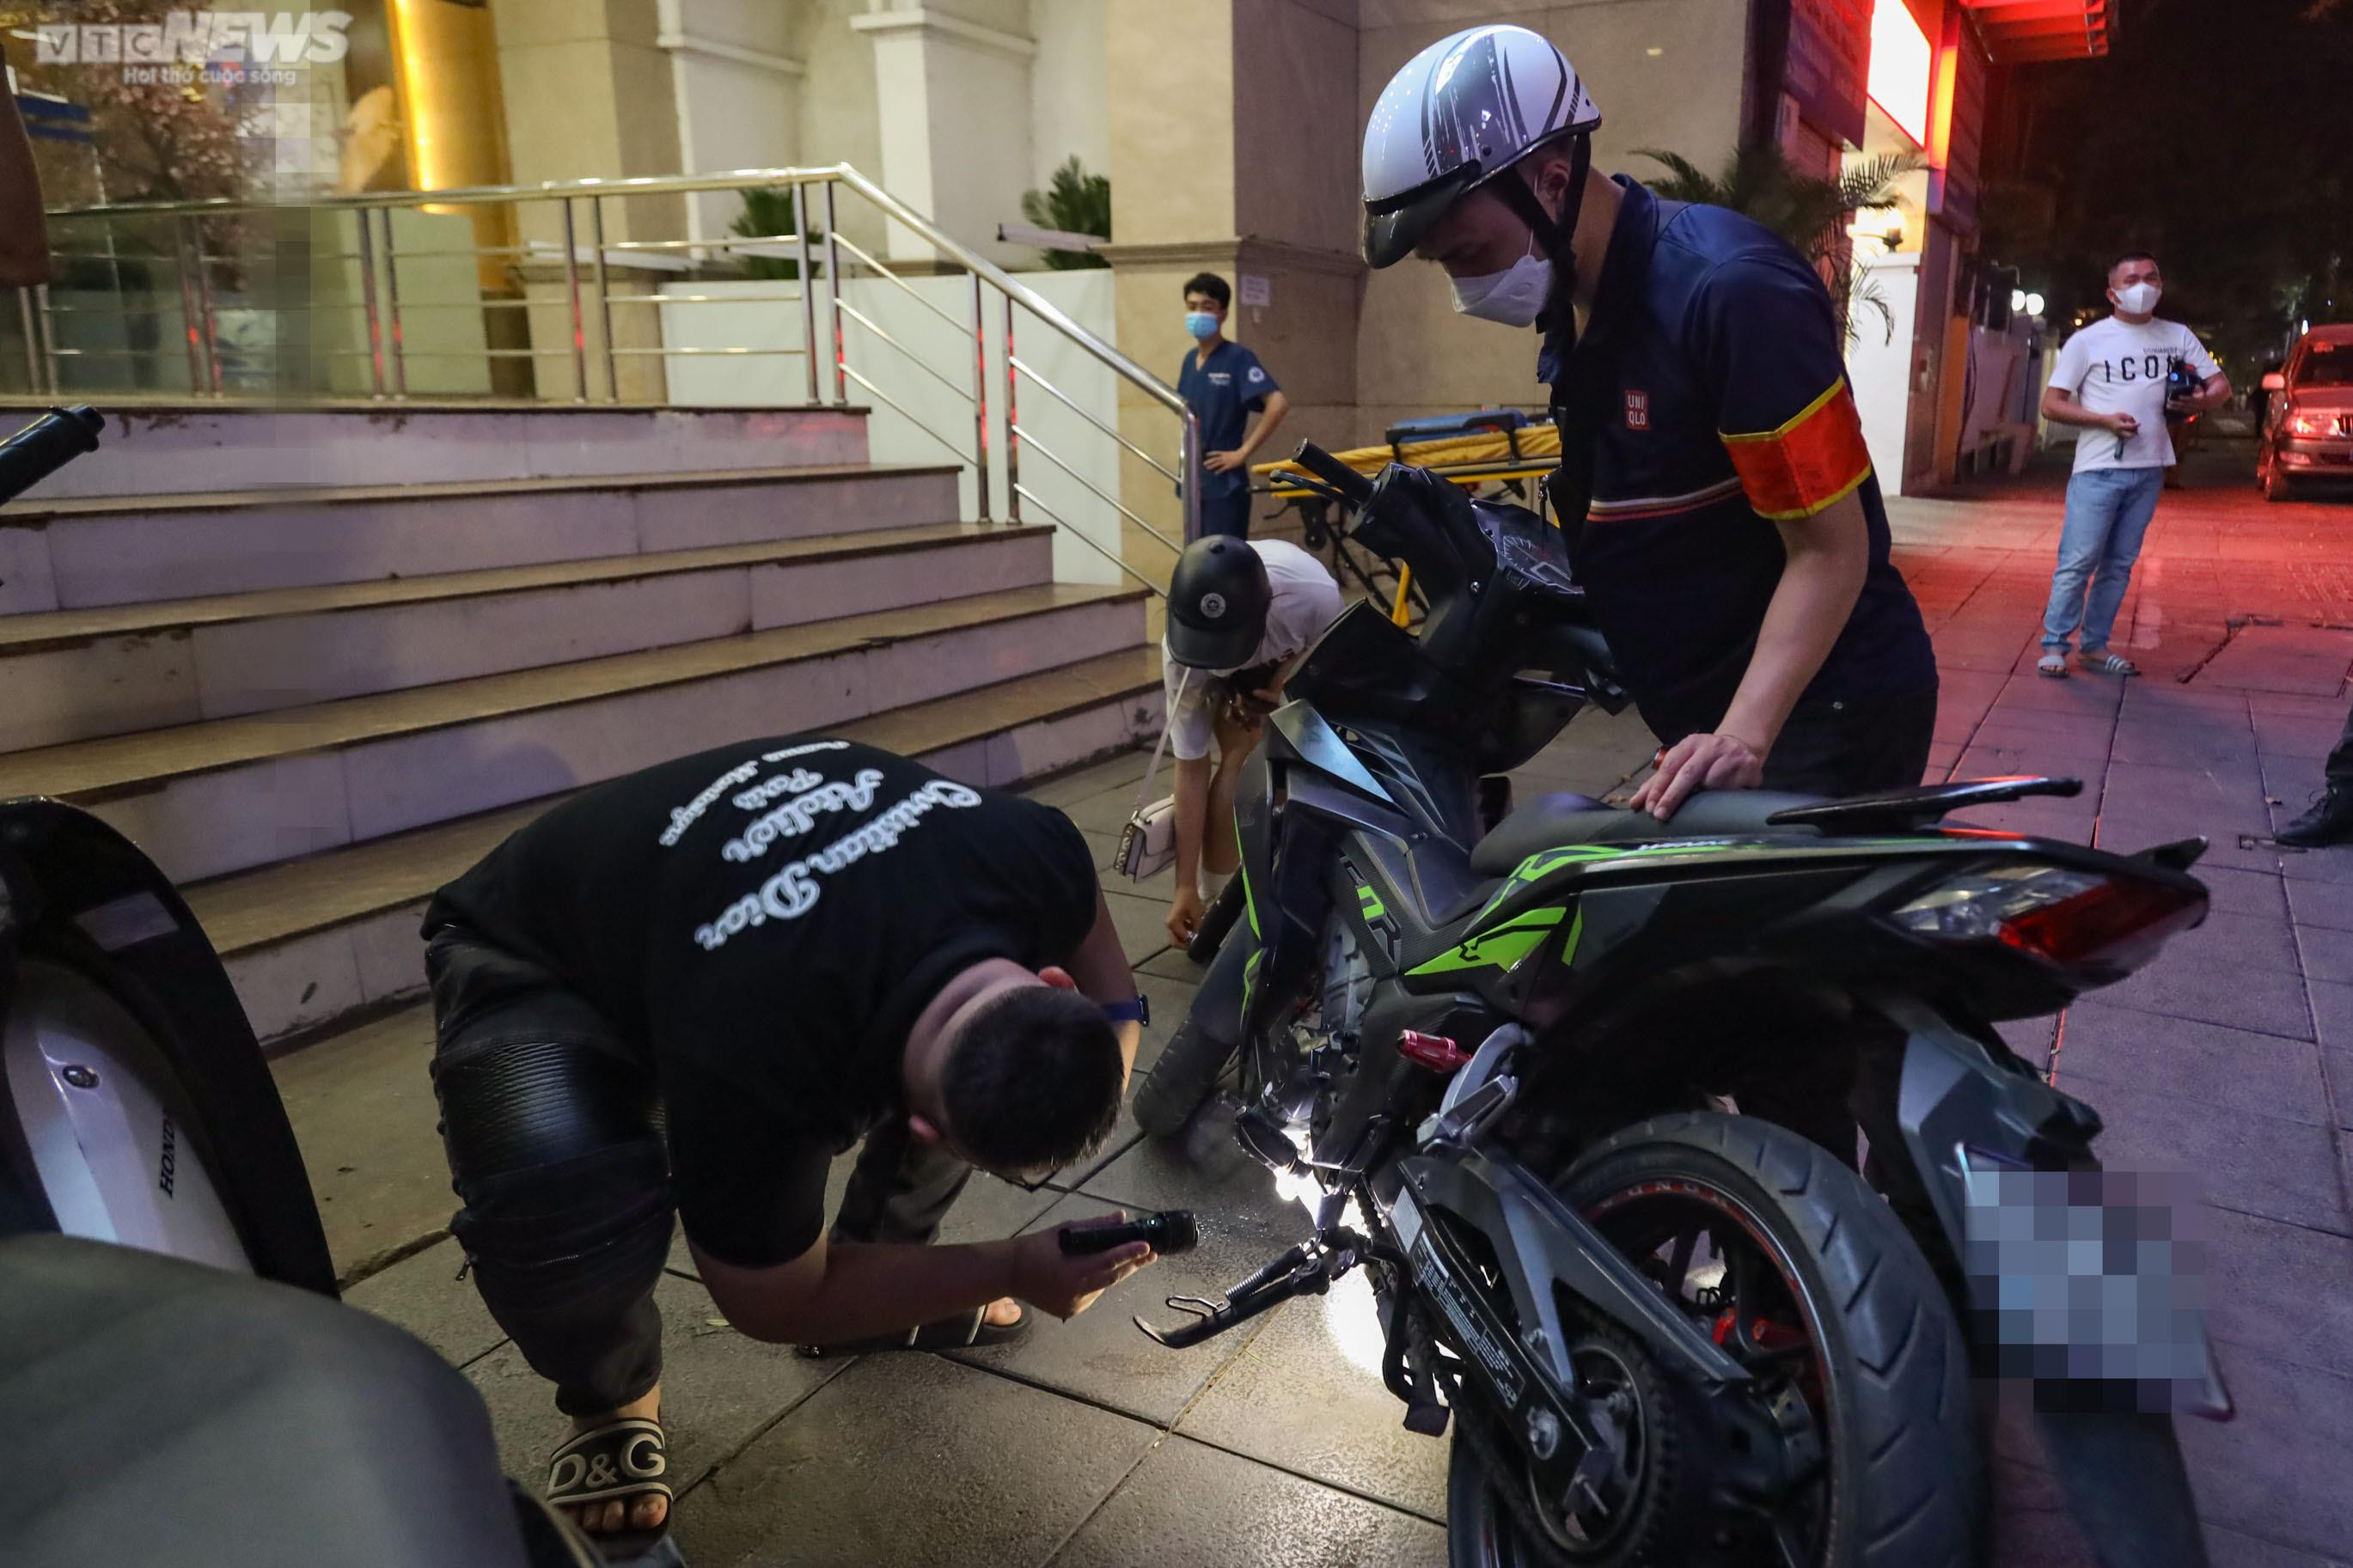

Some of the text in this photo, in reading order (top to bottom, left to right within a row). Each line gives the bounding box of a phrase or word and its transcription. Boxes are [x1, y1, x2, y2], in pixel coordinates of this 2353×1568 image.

[1628, 394, 1644, 409] UNI
[1629, 411, 1646, 426] QLO
[722, 768, 884, 863] Atelier
[732, 767, 823, 810] Paris
[694, 778, 981, 950] Christian Dior
[547, 1432, 666, 1497] D&G
